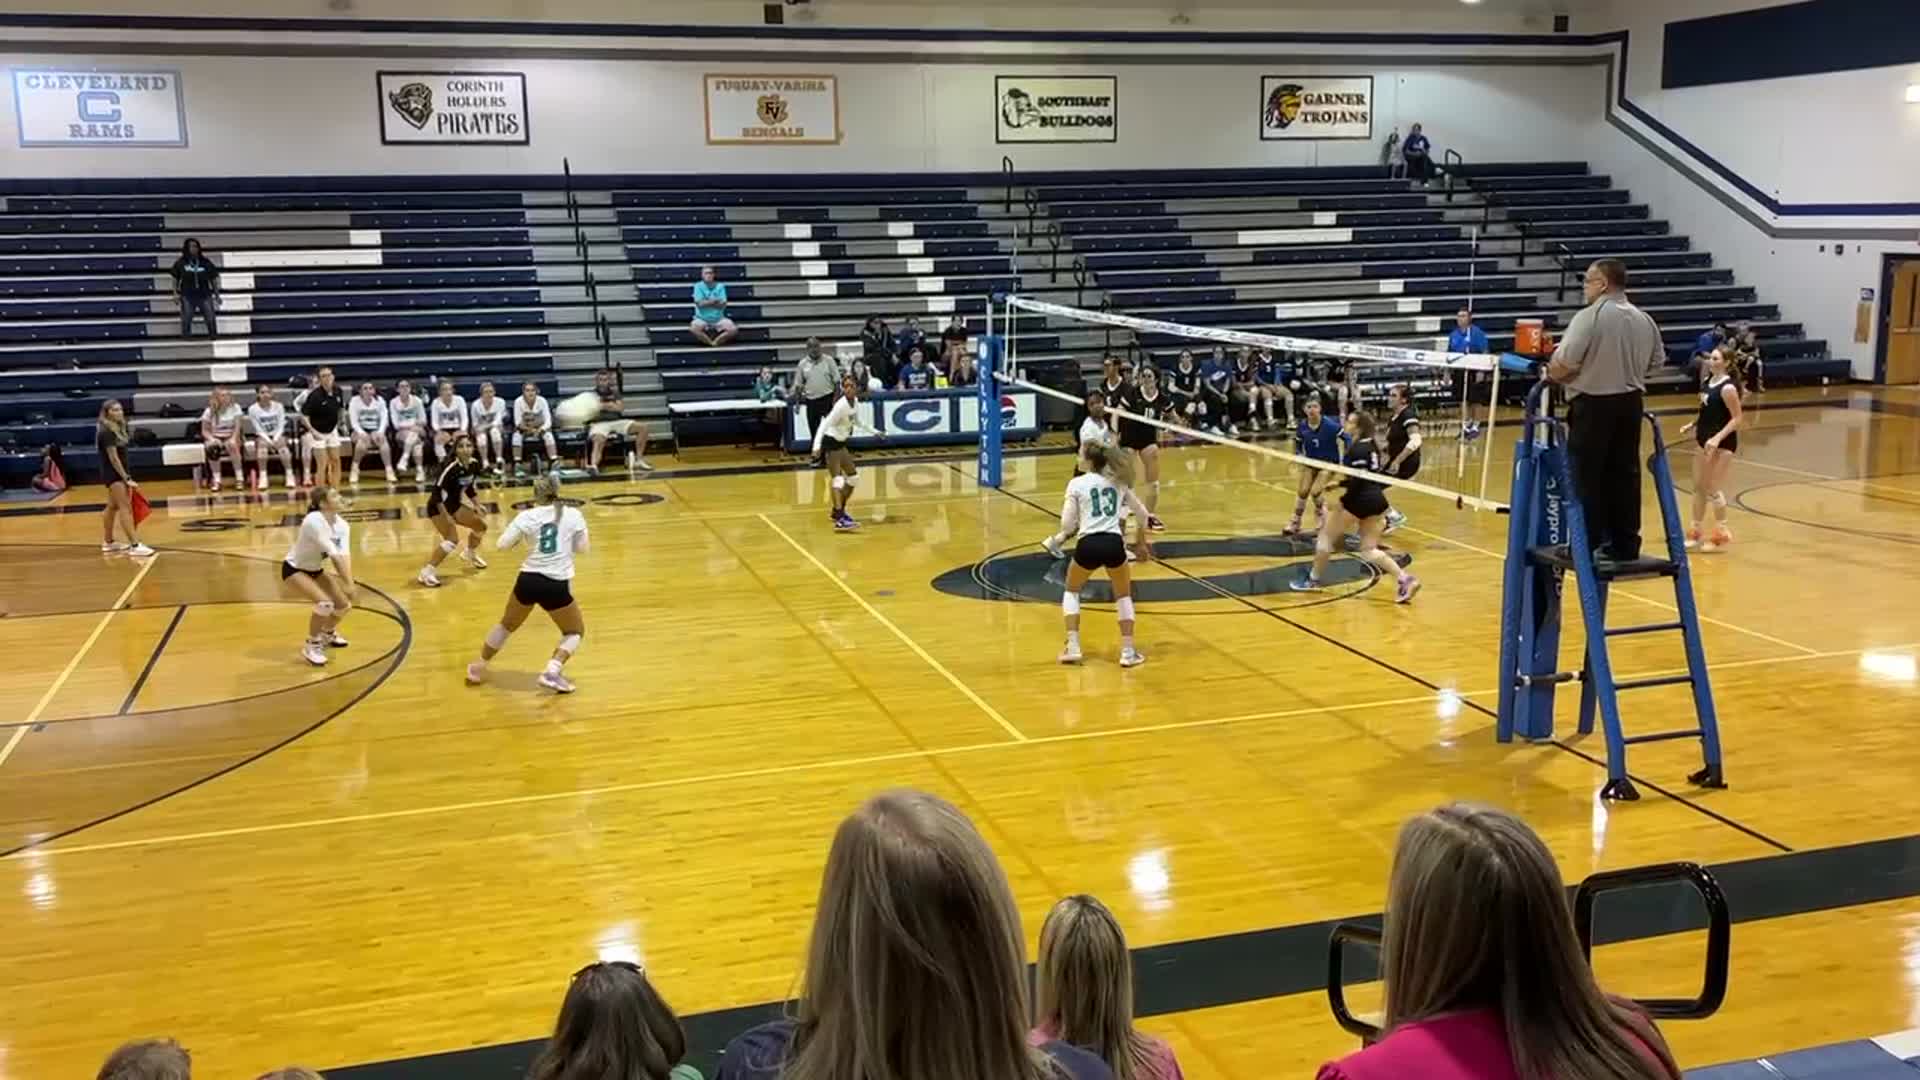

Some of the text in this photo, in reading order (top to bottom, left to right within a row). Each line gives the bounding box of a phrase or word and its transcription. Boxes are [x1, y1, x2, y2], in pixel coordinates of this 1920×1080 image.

[25, 75, 168, 90] CLEVELAND
[447, 81, 504, 92] CORINTH
[447, 96, 507, 107] HOLDERS
[1038, 96, 1111, 107] SOUTHEAST
[1303, 93, 1367, 105] GARNER
[437, 112, 519, 134] PIRATES
[1039, 115, 1113, 127] BULLDOGS
[1301, 111, 1369, 125] TROJANS
[69, 124, 135, 138] RAMS
[892, 400, 942, 432] C
[980, 365, 989, 482] CLAYTON
[1090, 487, 1117, 517] 13
[539, 522, 558, 554] 8
